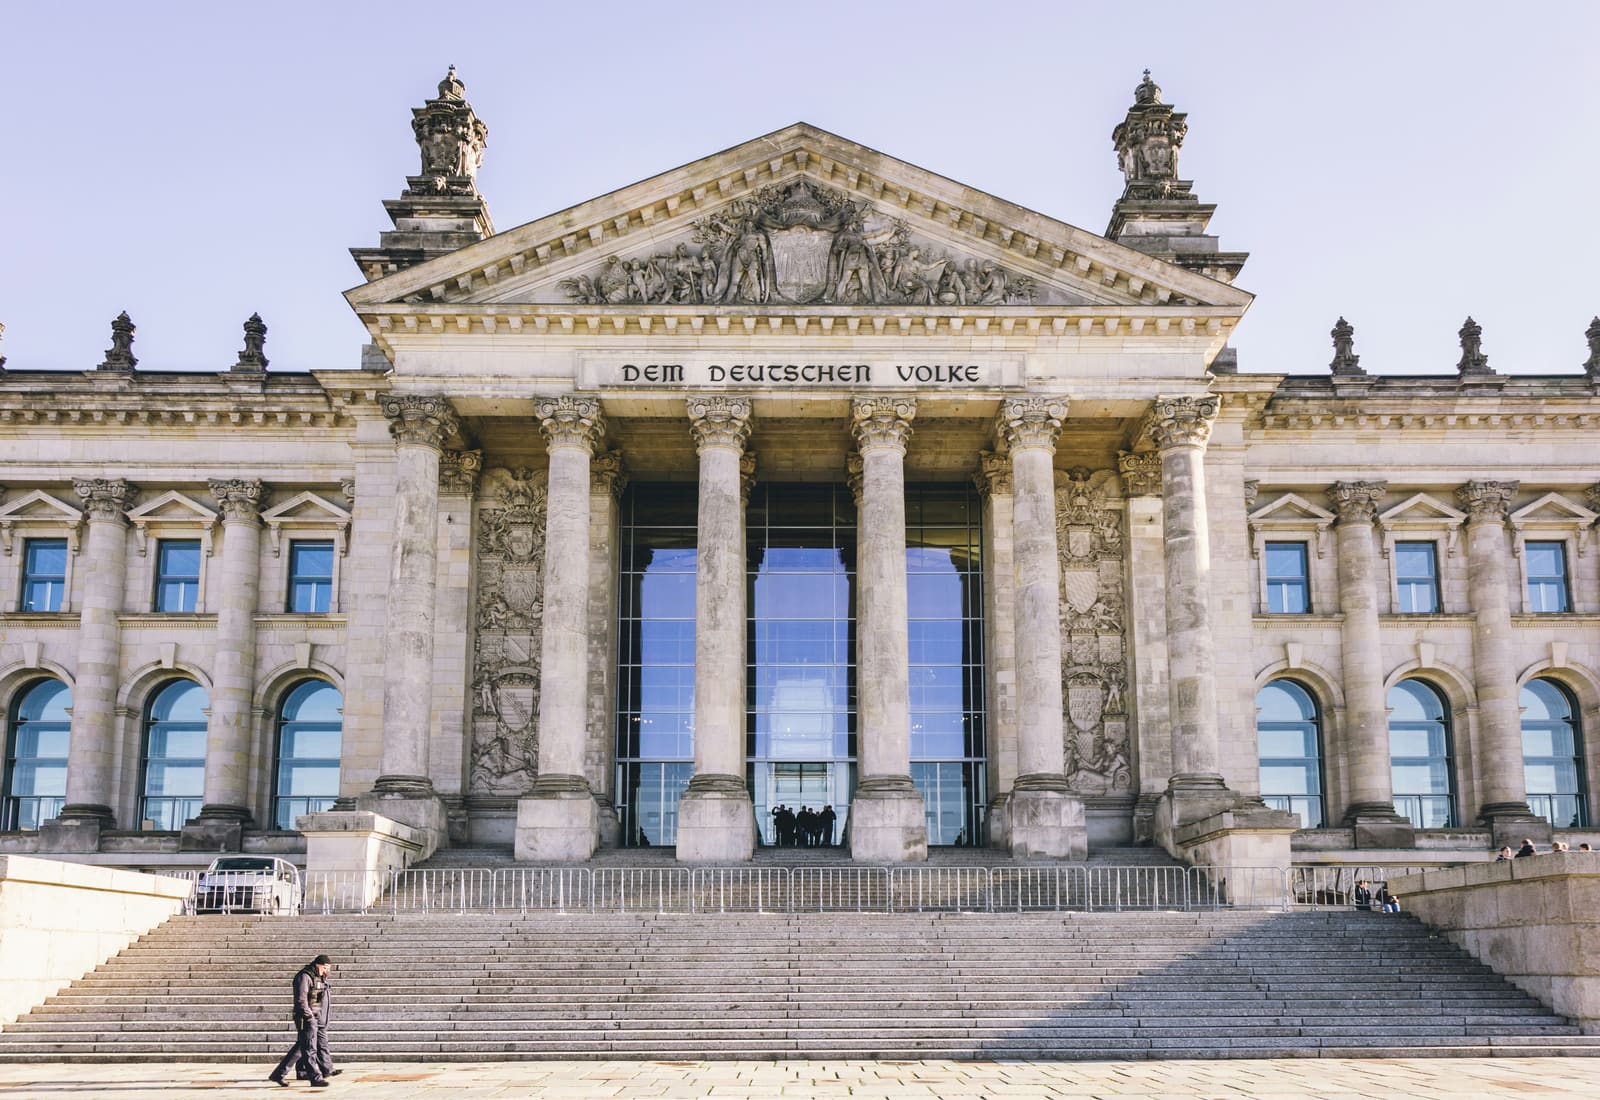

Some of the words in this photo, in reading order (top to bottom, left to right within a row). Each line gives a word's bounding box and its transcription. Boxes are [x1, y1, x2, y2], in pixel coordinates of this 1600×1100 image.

[621, 364, 684, 383] DEM
[708, 364, 871, 382] DEUTSCHEN
[896, 364, 980, 382] VOLKE
